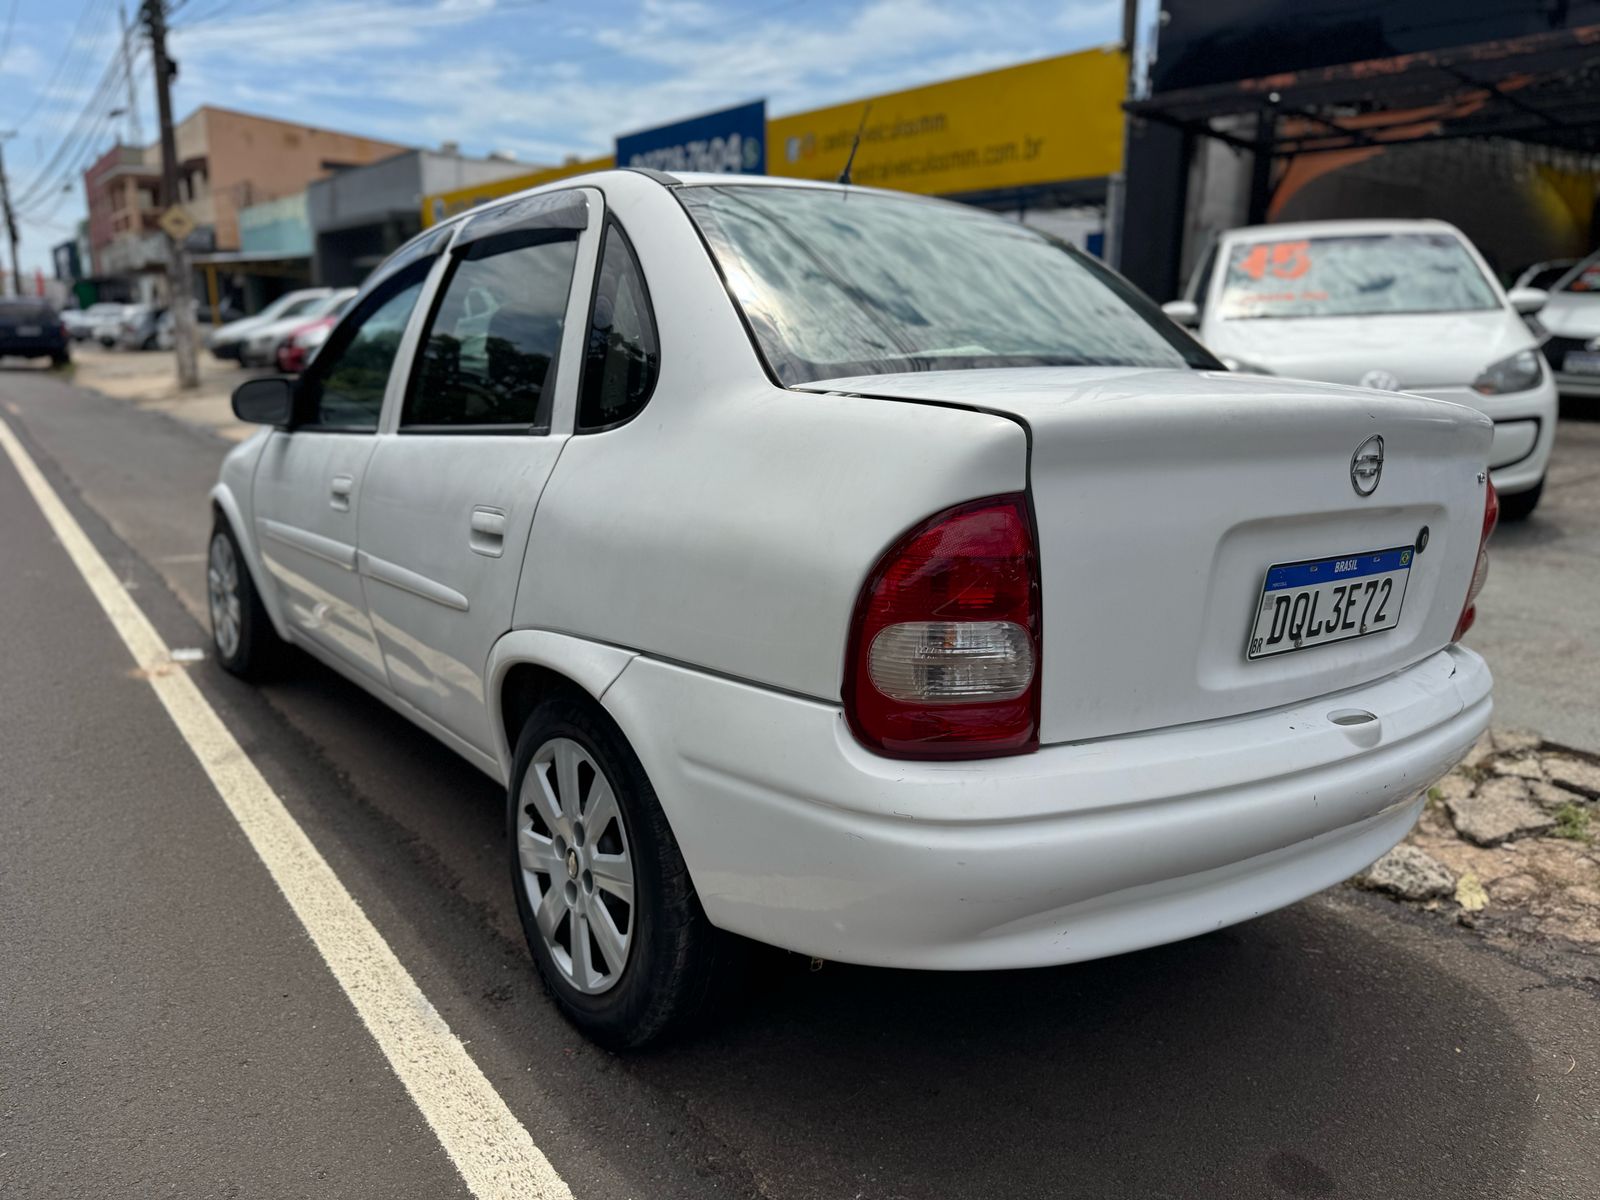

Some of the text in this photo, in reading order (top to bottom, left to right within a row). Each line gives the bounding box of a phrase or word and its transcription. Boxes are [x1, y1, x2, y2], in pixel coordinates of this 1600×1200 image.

[1334, 559, 1358, 573] BRASIL
[1266, 577, 1394, 645] DQL3E72
[1250, 637, 1264, 654] BR
